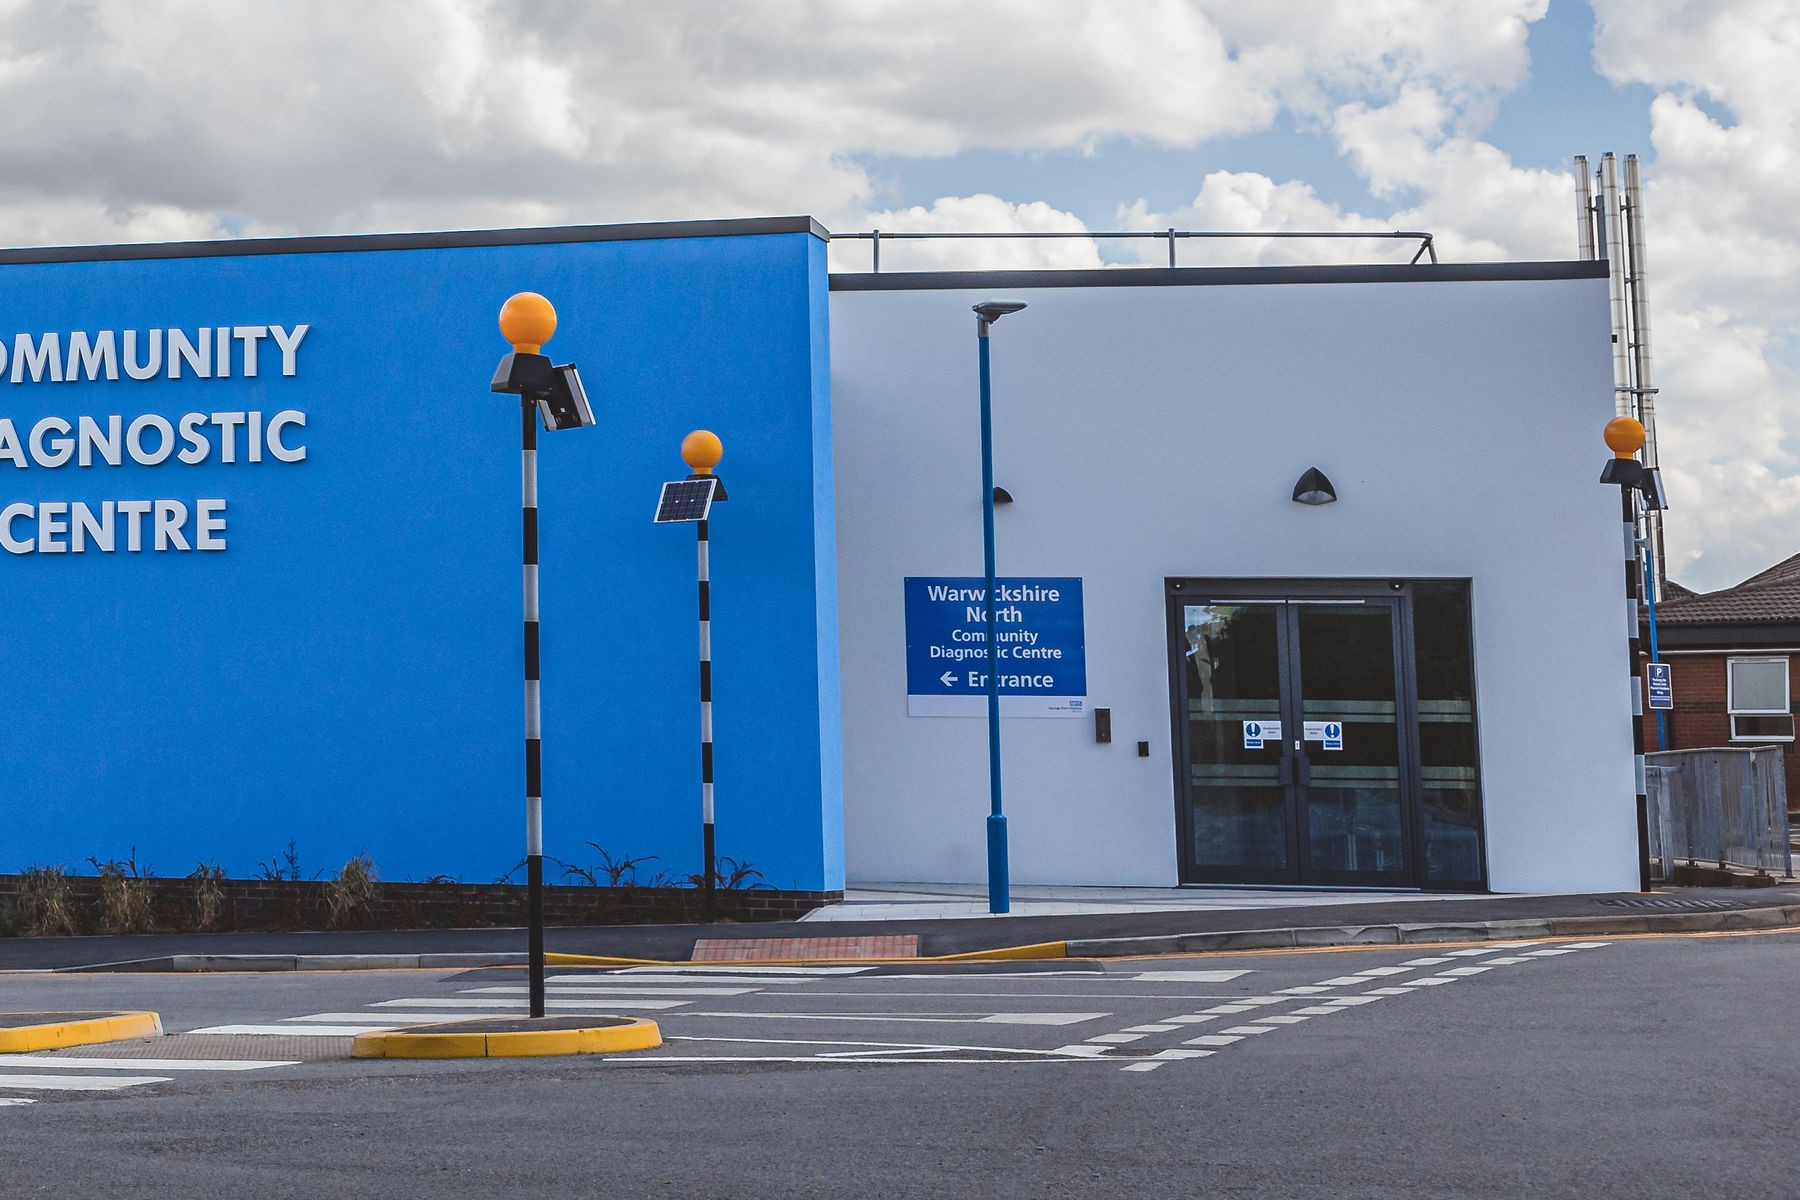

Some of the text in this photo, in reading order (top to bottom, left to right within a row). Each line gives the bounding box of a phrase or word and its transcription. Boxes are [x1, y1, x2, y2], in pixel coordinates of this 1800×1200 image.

[927, 585, 1060, 601] Warwkshire
[930, 645, 1062, 661] Diagnosic Centre
[968, 671, 1054, 687] Enrance
[1656, 667, 1662, 676] P
